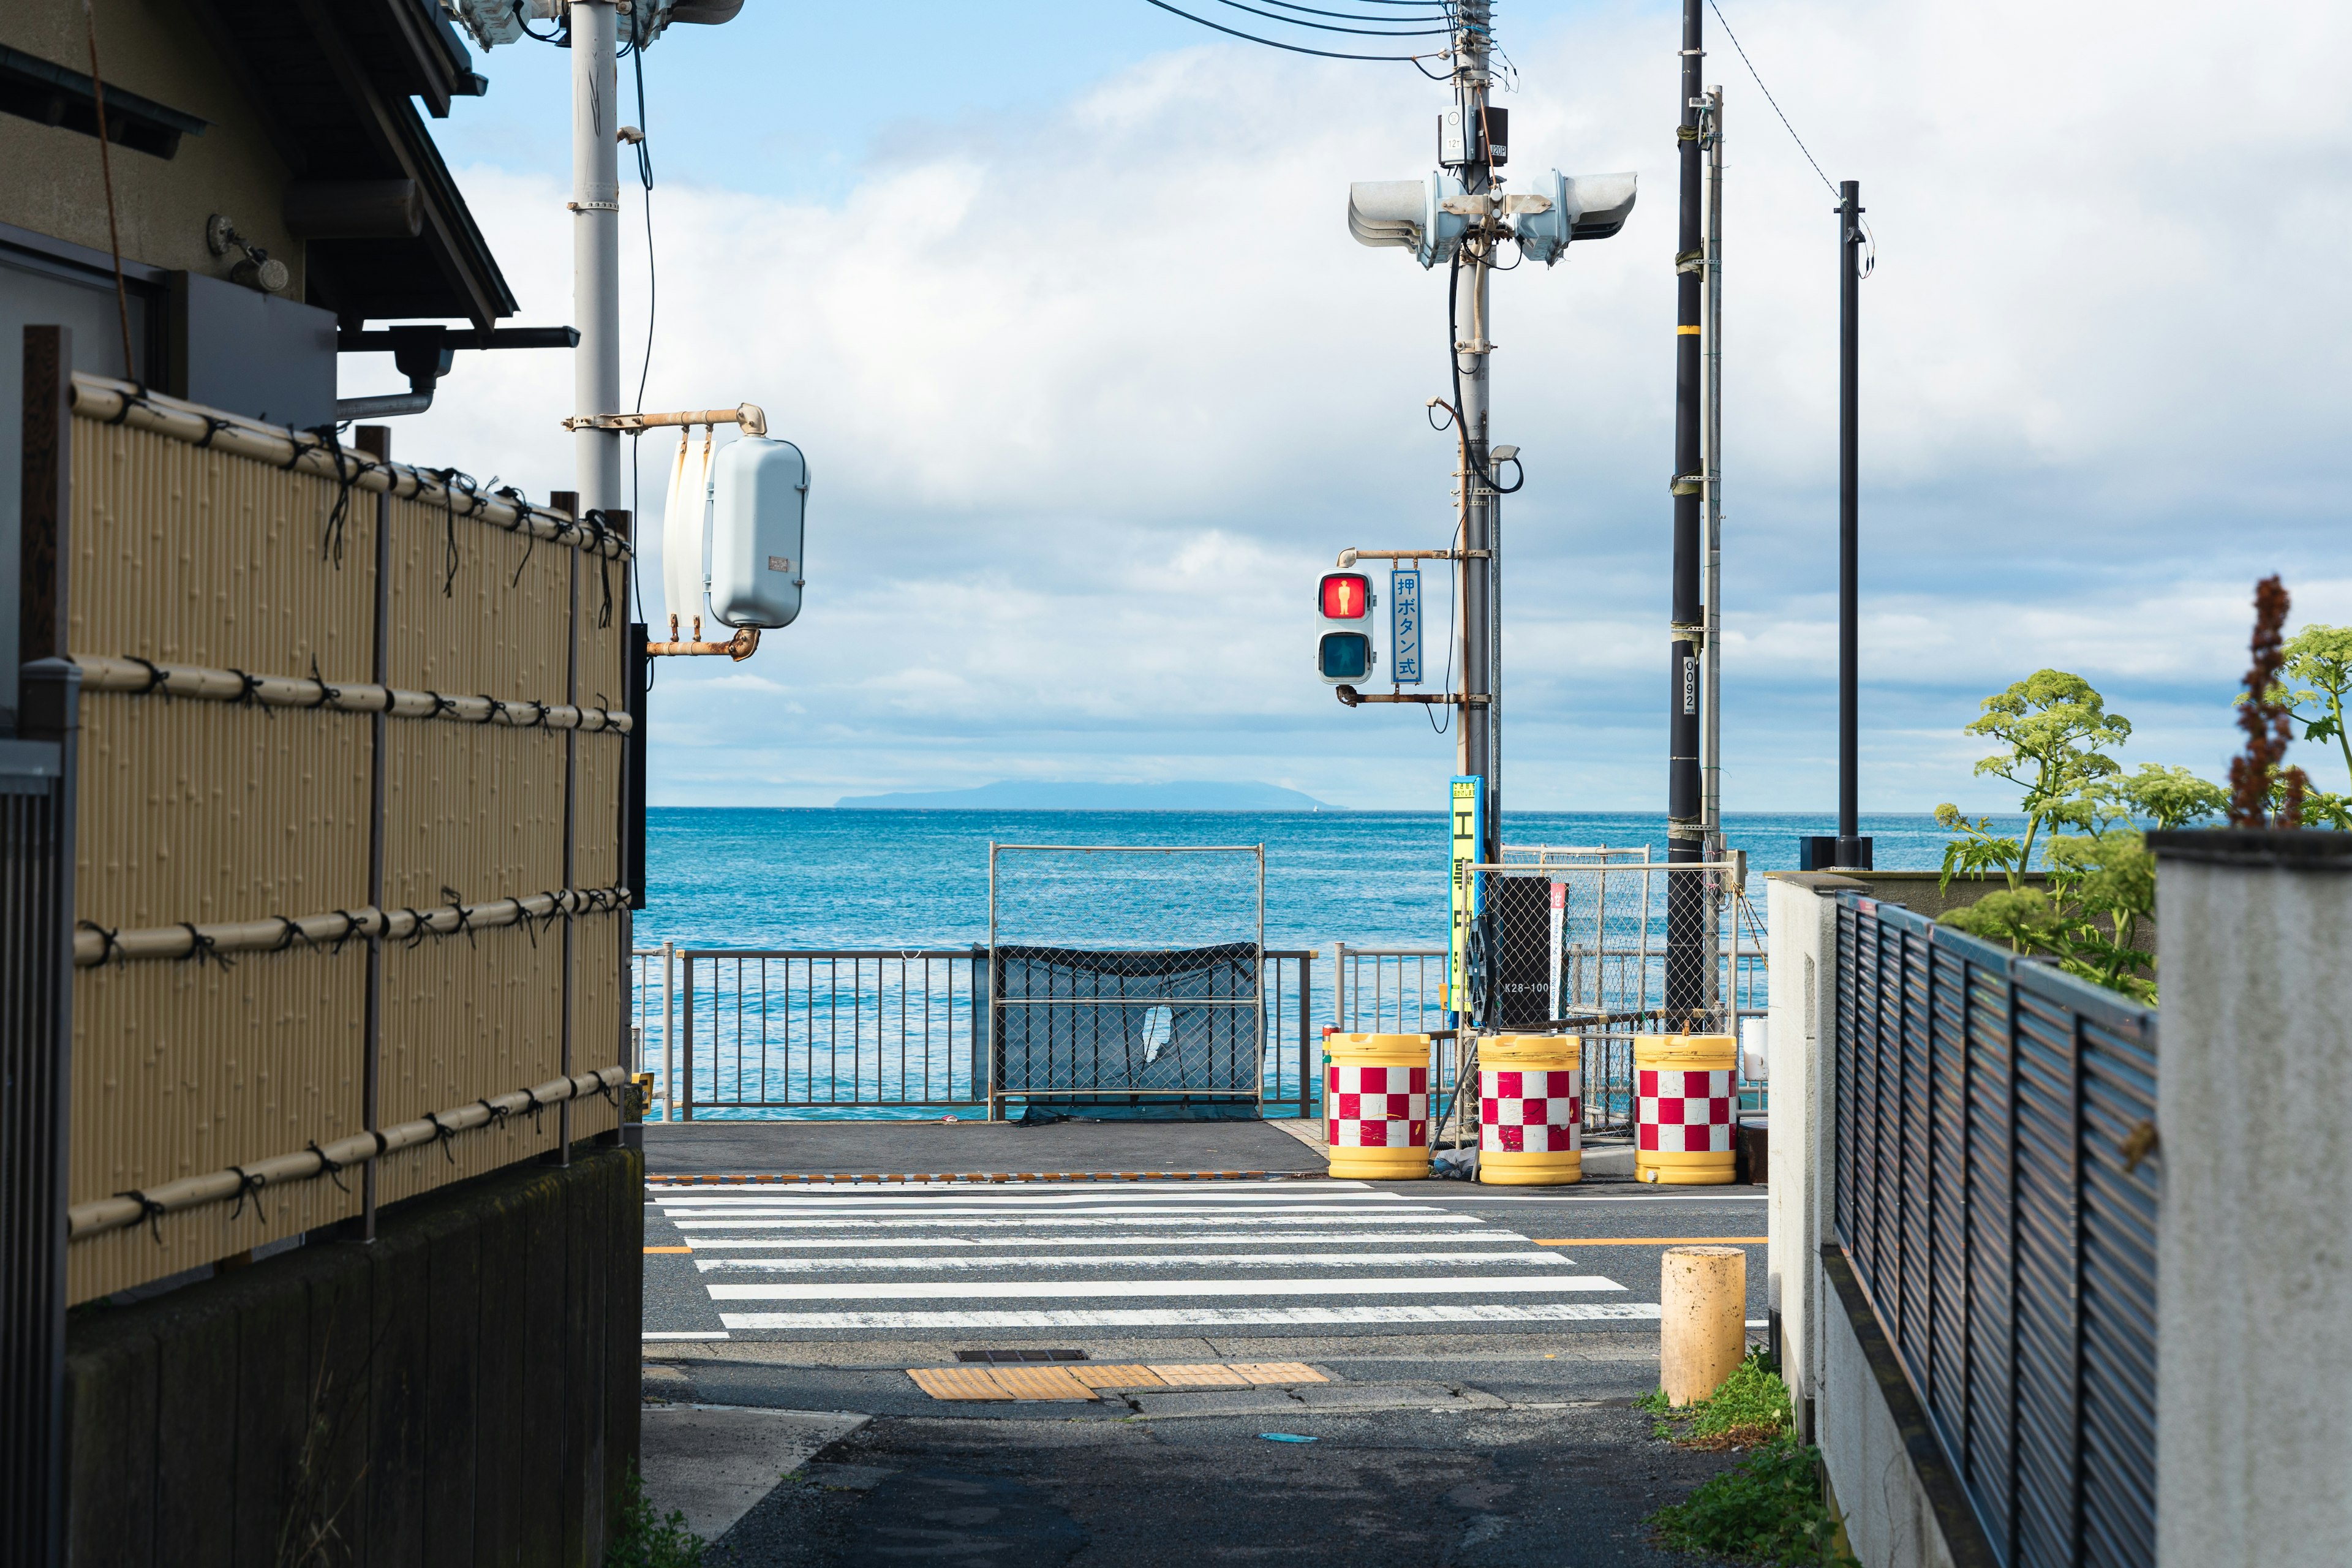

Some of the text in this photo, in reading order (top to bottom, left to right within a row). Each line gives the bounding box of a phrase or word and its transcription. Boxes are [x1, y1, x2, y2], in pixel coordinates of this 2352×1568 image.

[1449, 139, 1460, 148] 12T
[1491, 146, 1506, 156] J20P
[1398, 578, 1415, 675] 押ボタン式
[1505, 983, 1548, 992] K28-100
